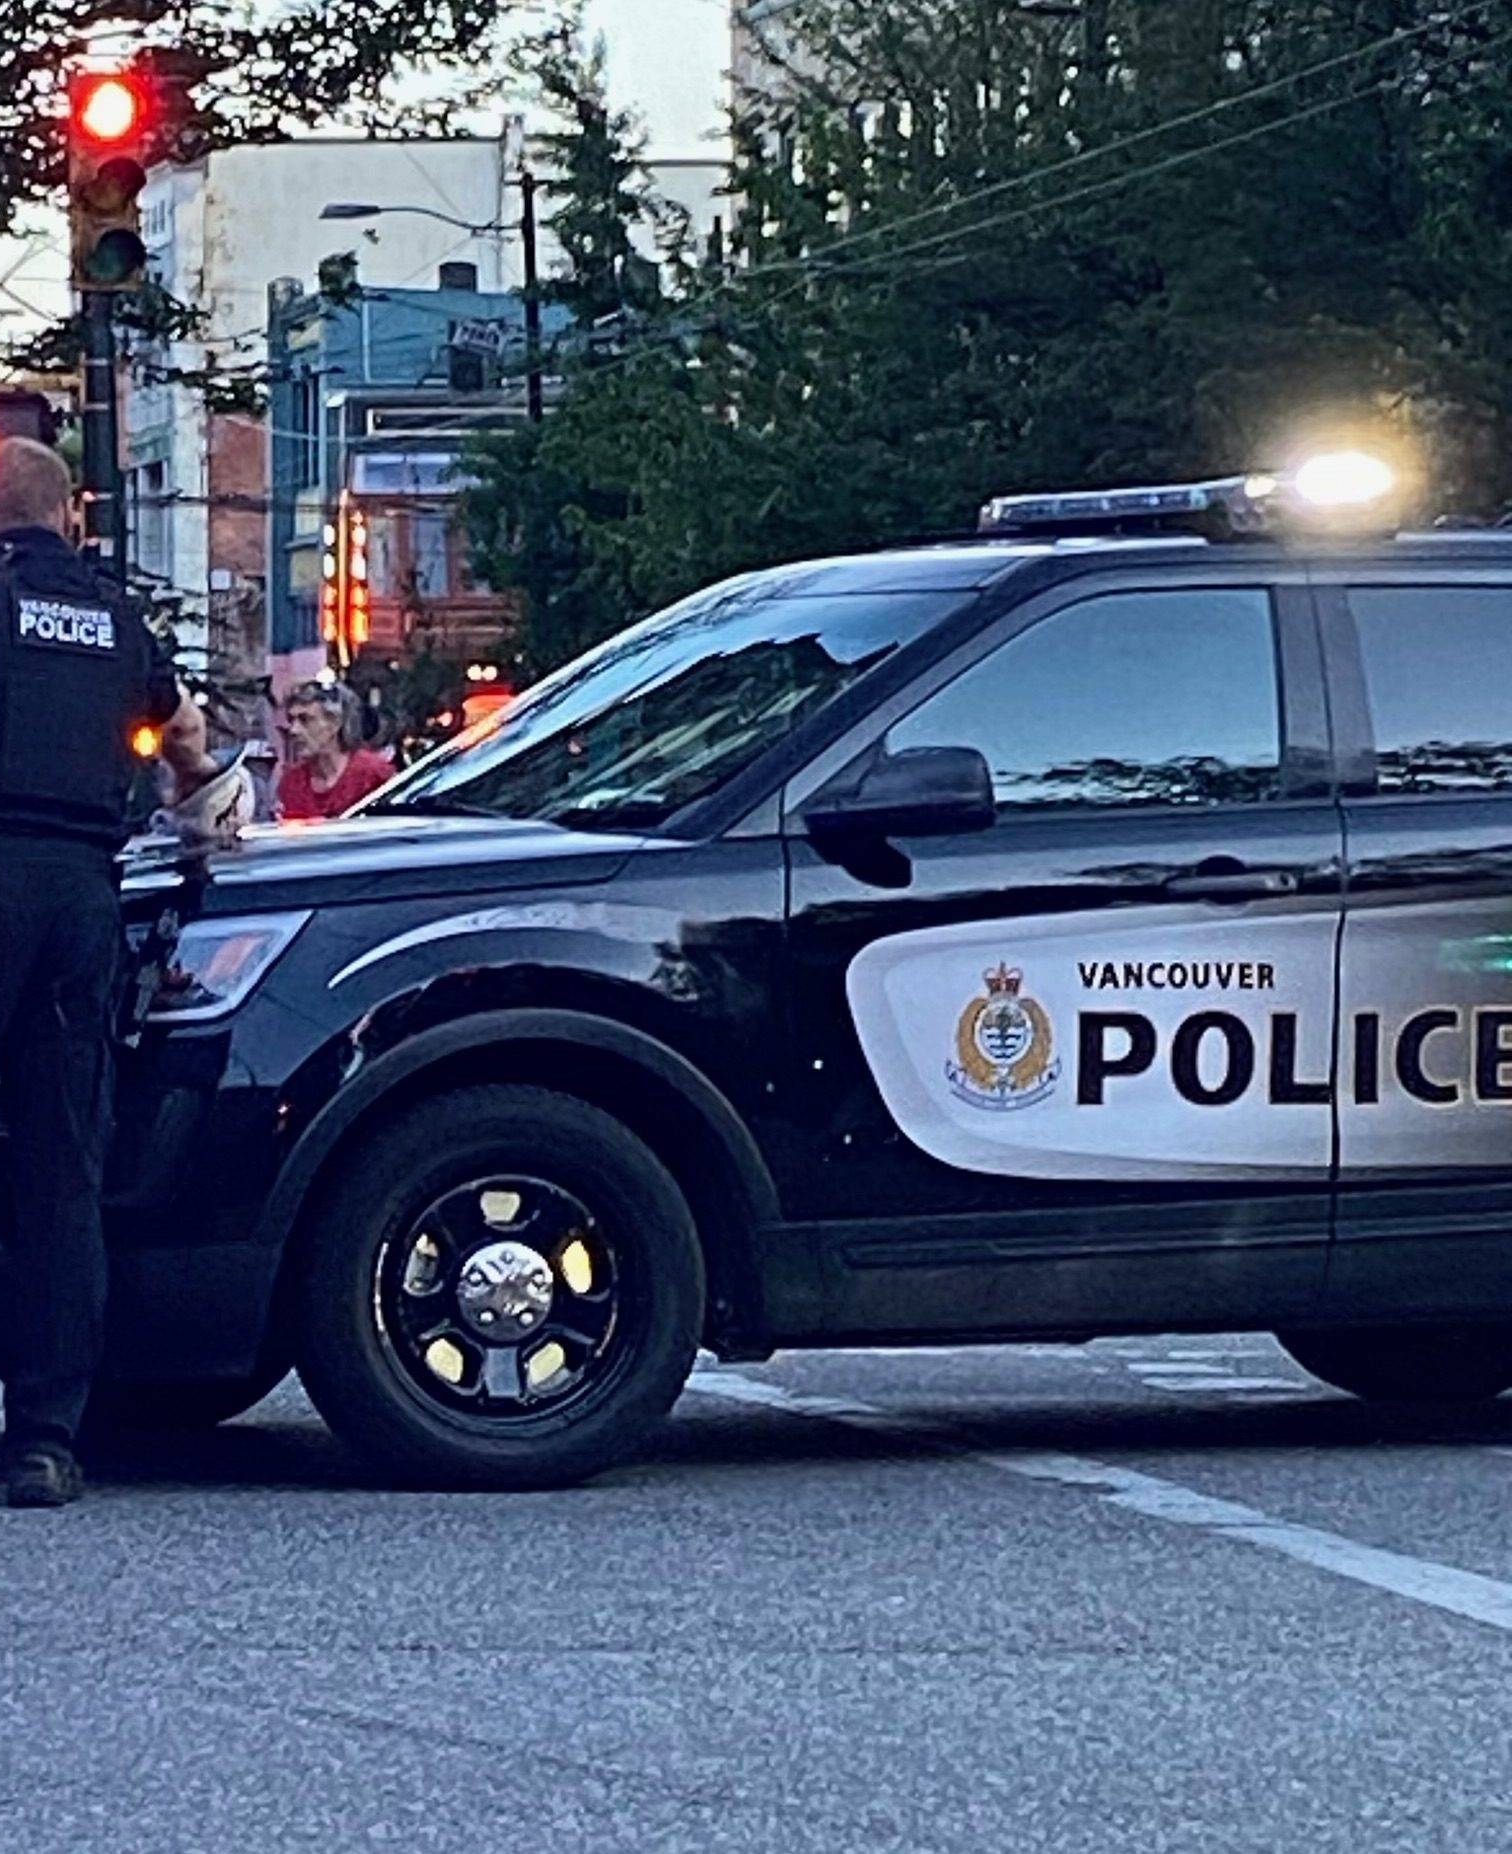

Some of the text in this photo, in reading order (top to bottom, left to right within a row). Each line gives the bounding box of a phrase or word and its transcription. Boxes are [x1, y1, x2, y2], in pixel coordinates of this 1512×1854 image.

[20, 612, 115, 648] POLICE
[1078, 962, 1275, 990] VANCOUVER
[1076, 1010, 1512, 1106] POLICE
